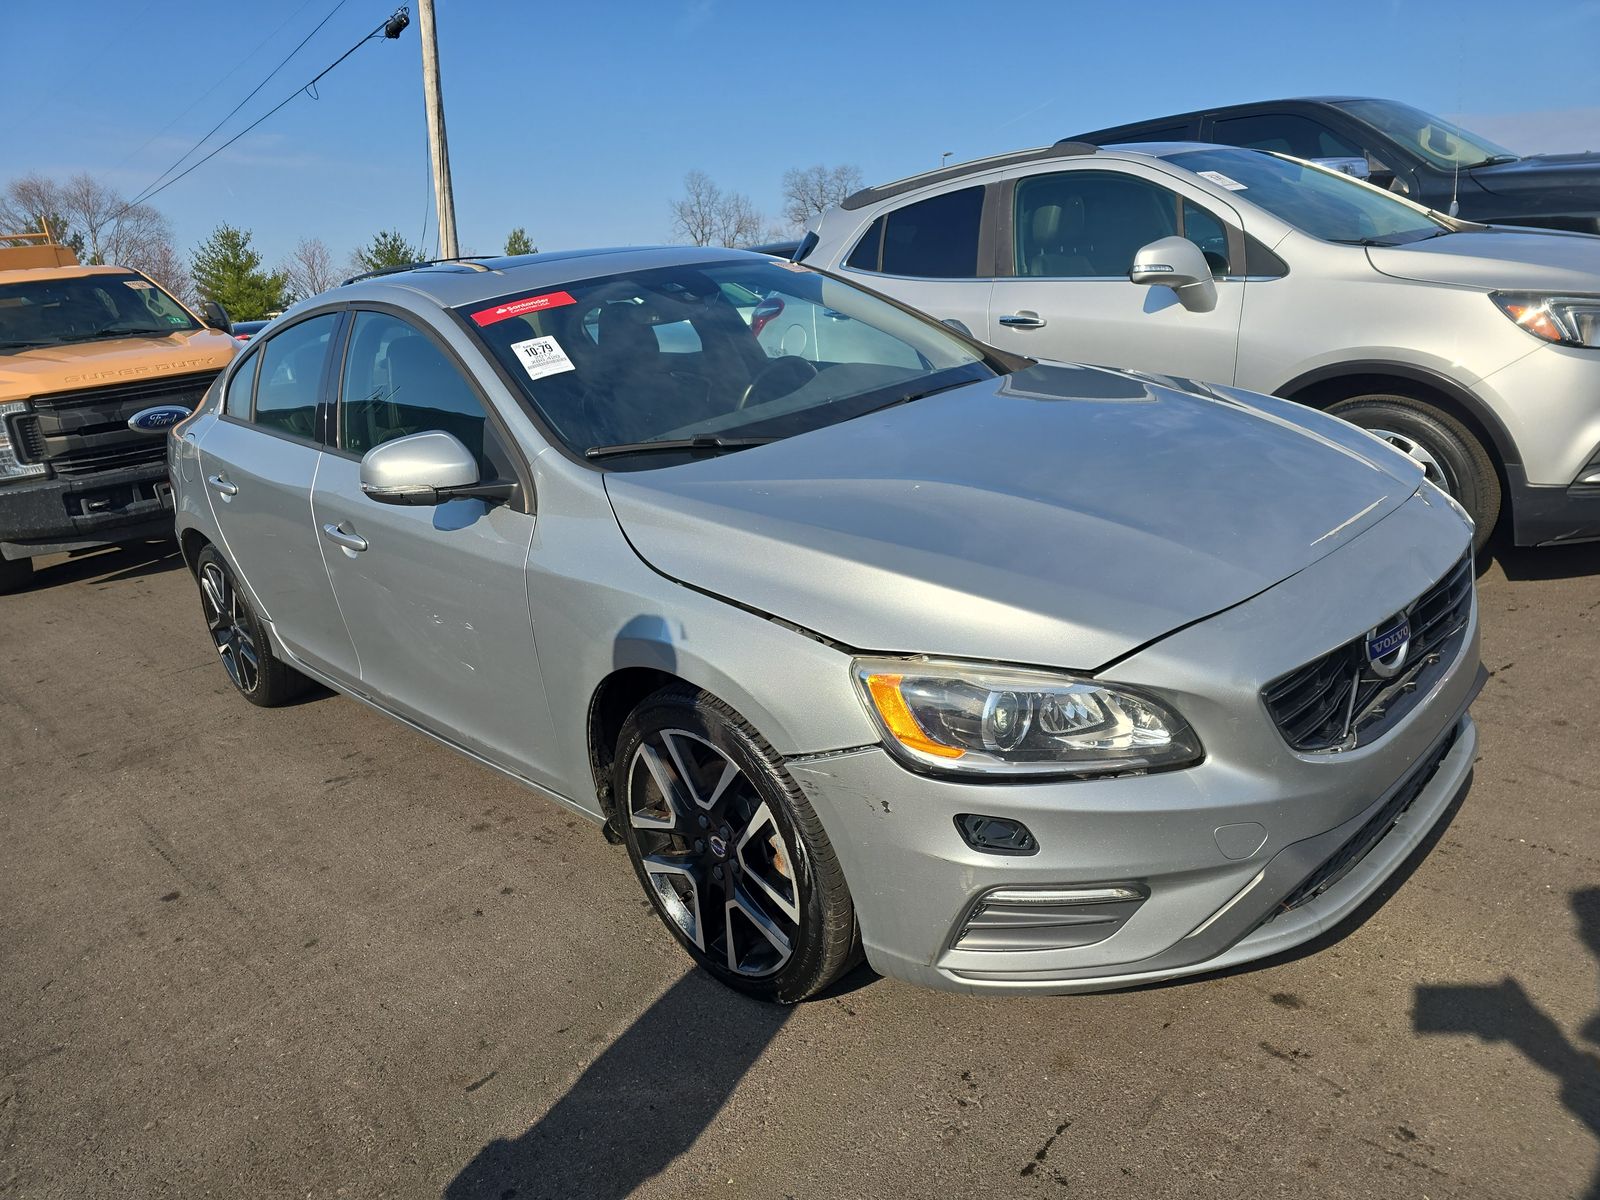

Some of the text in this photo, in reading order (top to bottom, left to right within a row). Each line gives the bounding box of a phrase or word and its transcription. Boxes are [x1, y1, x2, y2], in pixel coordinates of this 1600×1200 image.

[523, 343, 553, 357] 10:79
[64, 357, 215, 382] SUPER DUTY
[148, 412, 177, 425] Ford
[1372, 625, 1408, 653] VOLVO
